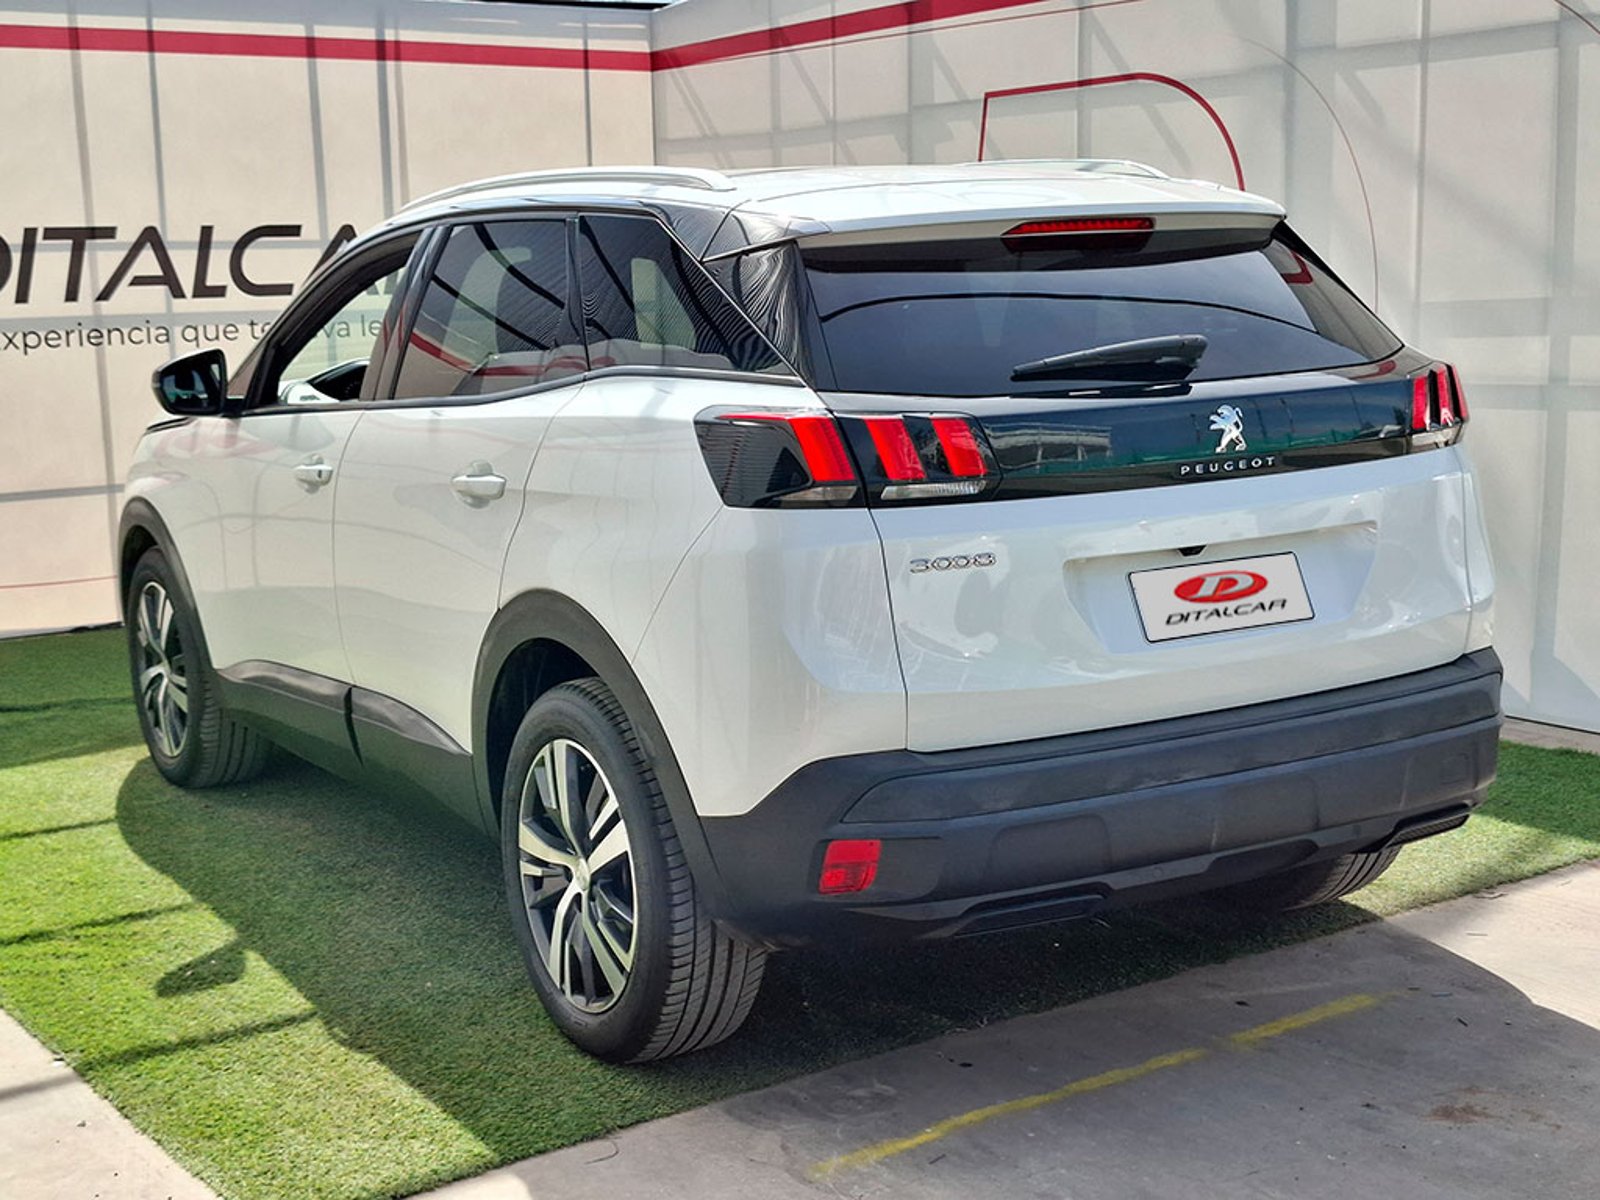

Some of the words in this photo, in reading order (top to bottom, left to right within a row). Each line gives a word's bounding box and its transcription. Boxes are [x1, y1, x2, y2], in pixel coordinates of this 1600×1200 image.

[0, 319, 170, 356] xperiencia
[181, 323, 239, 347] que
[1180, 456, 1275, 475] PEUGEOT
[909, 552, 997, 573] 3008
[1165, 598, 1288, 626] DITALCAR
